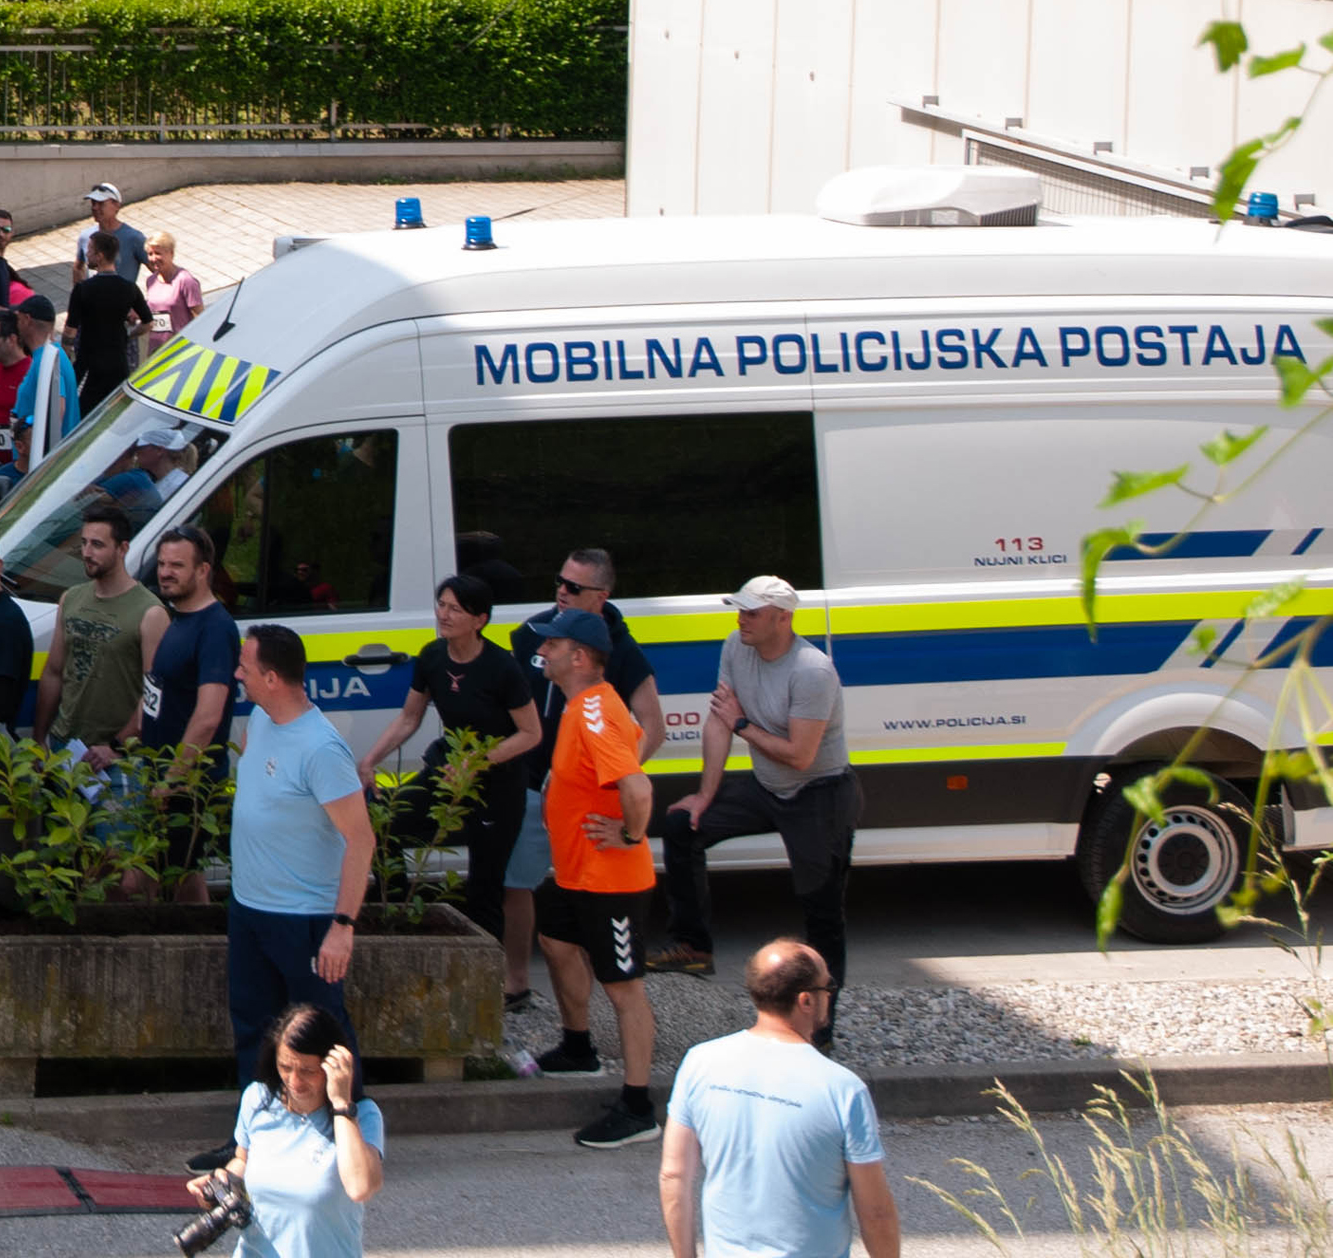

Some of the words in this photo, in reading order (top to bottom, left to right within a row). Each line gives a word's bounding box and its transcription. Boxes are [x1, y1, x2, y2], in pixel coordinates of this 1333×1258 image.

[474, 337, 725, 386] MOBILNA
[735, 327, 1049, 377] POLICIJSKA
[1058, 324, 1308, 368] POSTAJA
[994, 537, 1044, 552] 113
[974, 556, 1023, 567] NUJNI
[1027, 554, 1068, 565] KLICI
[883, 715, 1027, 731] WWW.POLICIJA.SI
